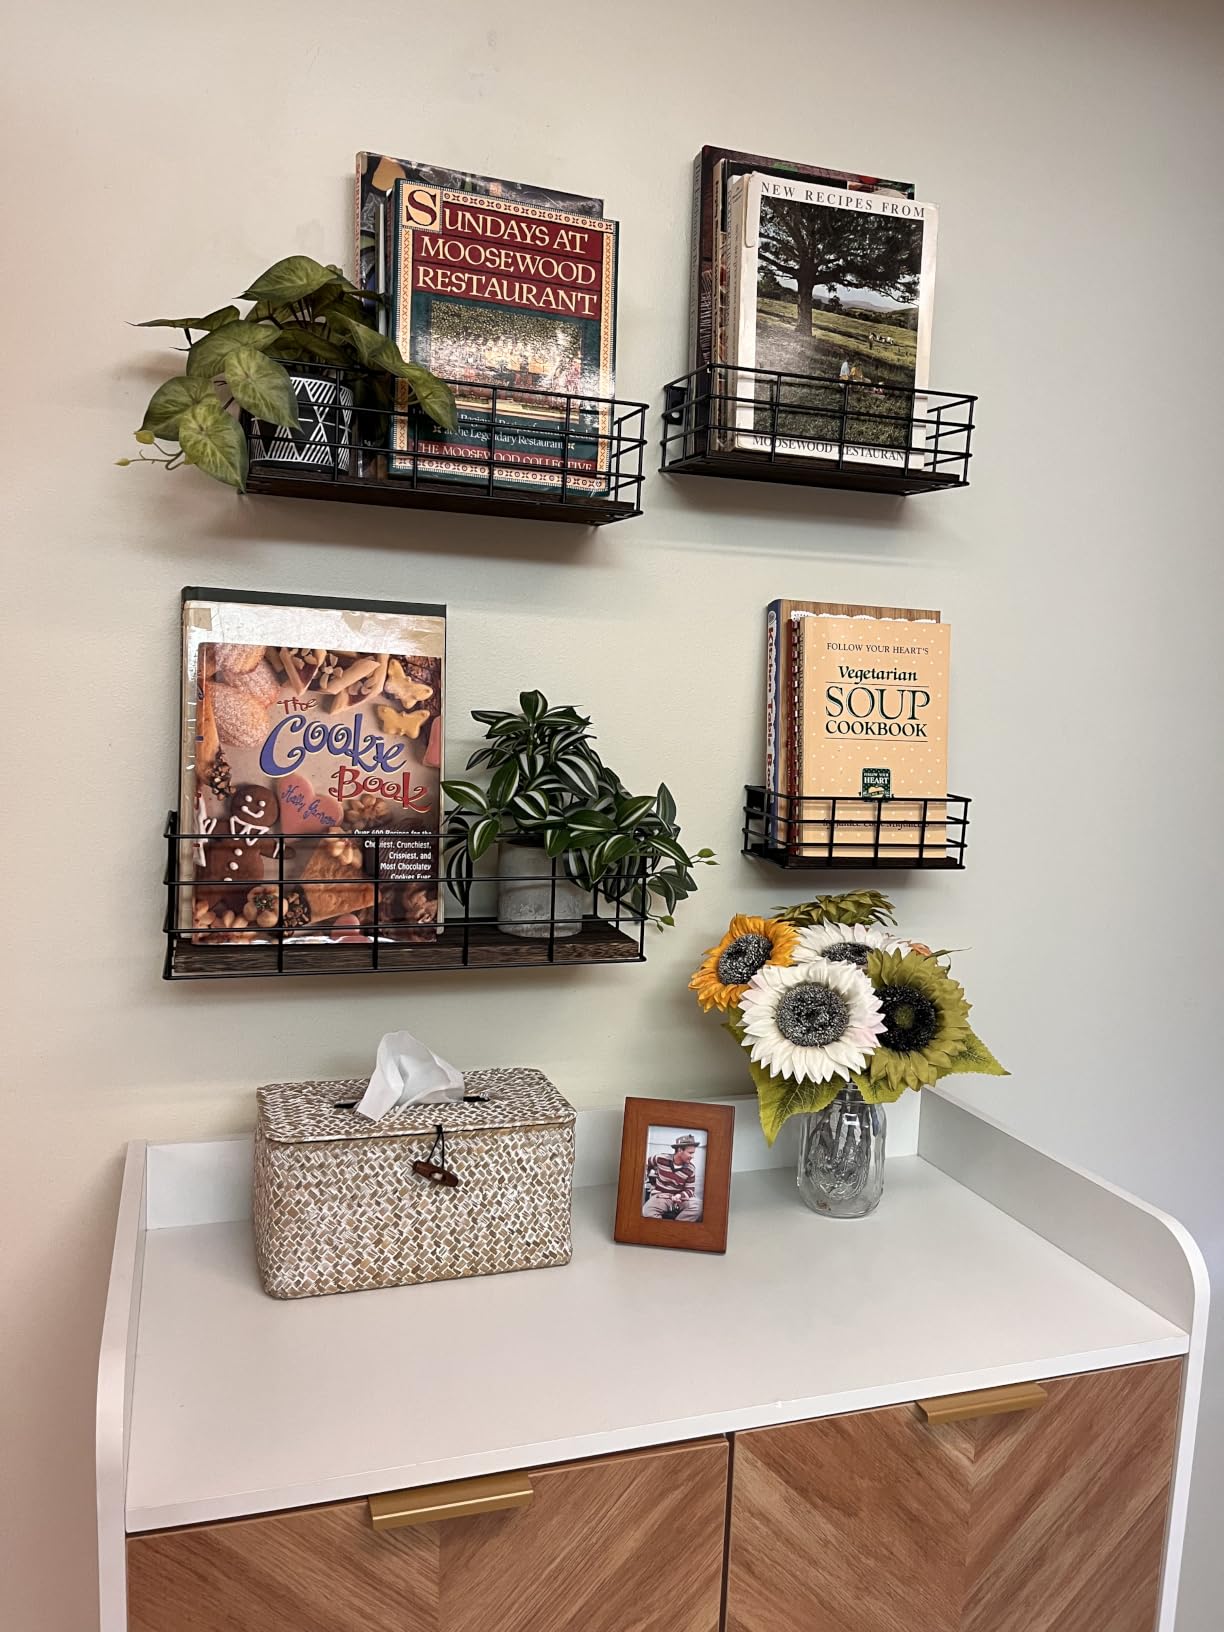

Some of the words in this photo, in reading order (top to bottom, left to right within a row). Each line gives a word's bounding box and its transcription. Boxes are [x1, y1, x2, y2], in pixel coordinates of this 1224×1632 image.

[761, 180, 796, 198] NEW
[805, 189, 873, 211] RECIPES
[882, 202, 925, 218] FROM
[406, 189, 550, 247] SUNDAYS
[553, 229, 588, 254] AT
[421, 236, 596, 286] MOOSEWOOD
[417, 266, 597, 316] RESTAURANT
[826, 642, 863, 652] FOLLOW
[865, 644, 890, 653] YOUR
[892, 646, 929, 655] HEART'S
[837, 665, 918, 684] Vegetarian
[277, 697, 318, 714] The
[825, 685, 931, 720] SOUP
[259, 713, 407, 777] Cookie
[825, 720, 928, 737] COOKBOOK
[328, 765, 432, 813] Book
[380, 862, 396, 870] Most
[420, 852, 432, 860] and
